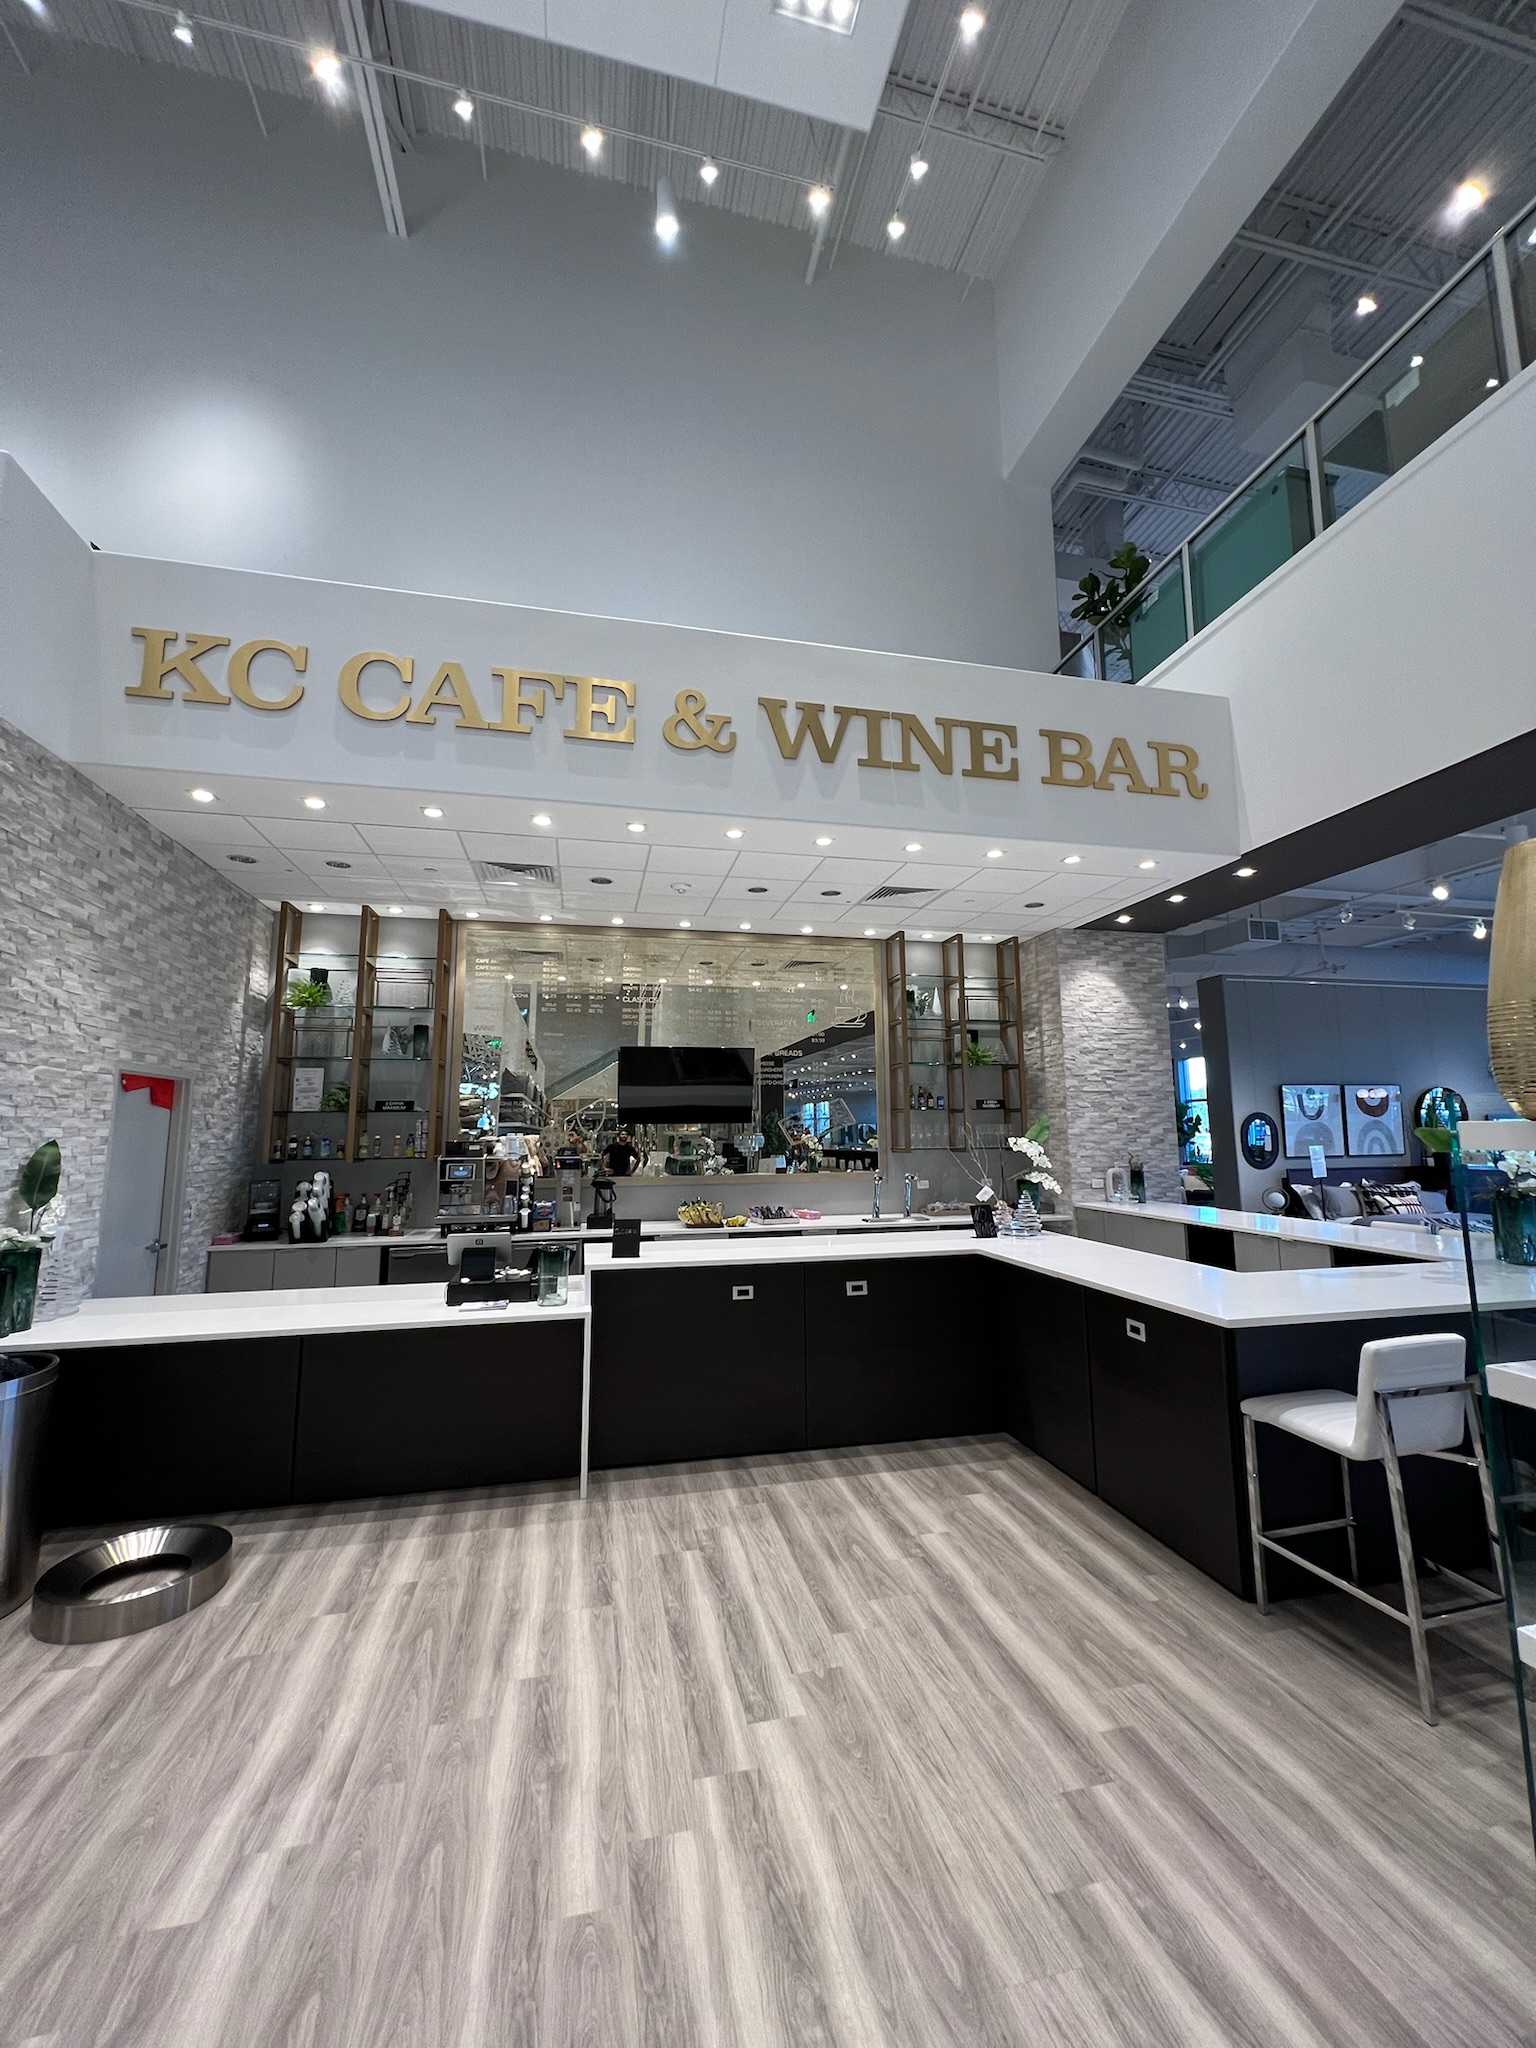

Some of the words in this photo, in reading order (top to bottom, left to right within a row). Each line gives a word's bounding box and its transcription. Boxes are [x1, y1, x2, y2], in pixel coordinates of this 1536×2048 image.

[124, 626, 307, 711] KC
[338, 651, 636, 744] CAFE
[663, 689, 737, 752] &
[757, 697, 1019, 781] WINE
[1039, 728, 1208, 799] BAR
